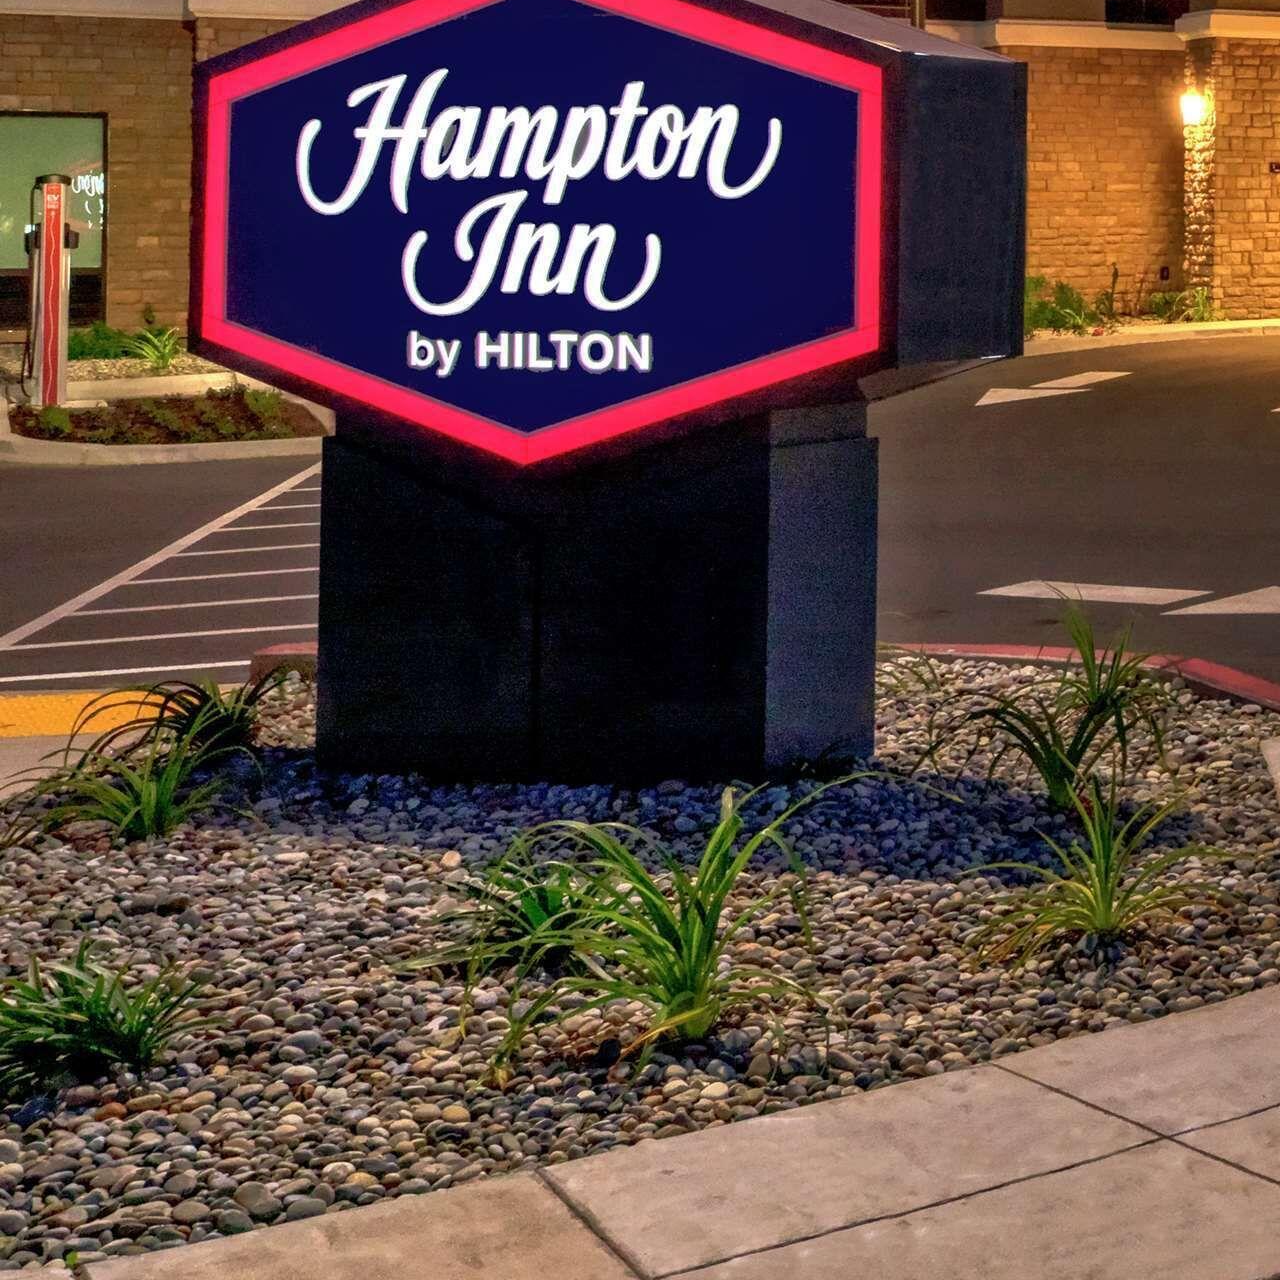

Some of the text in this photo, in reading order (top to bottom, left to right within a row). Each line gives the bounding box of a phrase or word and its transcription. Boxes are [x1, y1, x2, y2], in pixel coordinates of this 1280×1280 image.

[296, 67, 783, 217] Hampton
[401, 189, 662, 317] Inn
[408, 330, 652, 377] by HILTON
